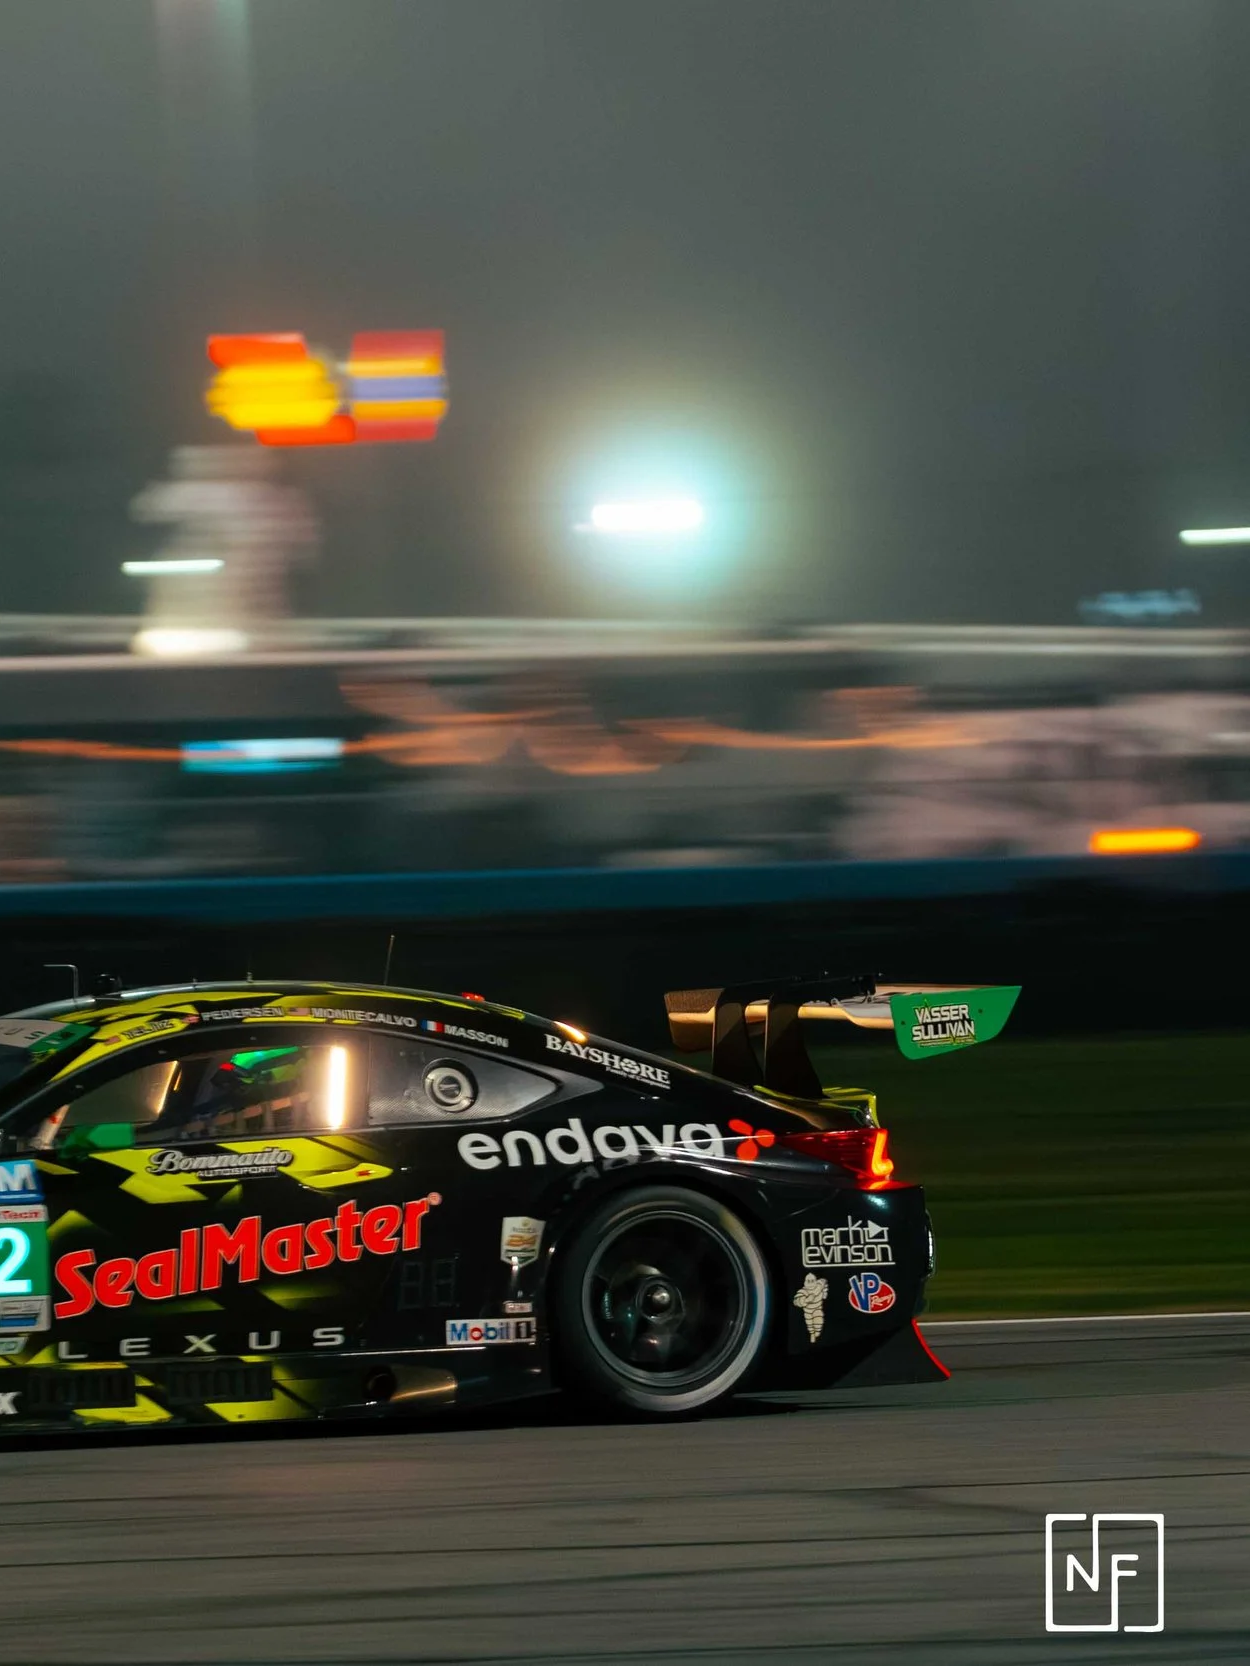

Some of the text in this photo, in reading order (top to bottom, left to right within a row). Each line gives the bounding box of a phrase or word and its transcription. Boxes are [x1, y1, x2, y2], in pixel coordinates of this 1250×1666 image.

[201, 1007, 284, 1021] PEDERSEN
[310, 1007, 417, 1028] MONTECALVO
[443, 1025, 509, 1048] MASSON
[912, 1020, 975, 1041] SULLIVAN
[915, 1004, 969, 1024] VASSER
[544, 1033, 671, 1084] BAYSHORE
[457, 1118, 726, 1170] endava
[196, 1165, 279, 1178] AUTOSPORT
[802, 1215, 865, 1246] mark
[54, 1198, 430, 1319] SealMaster
[849, 1272, 881, 1312] VP
[58, 1326, 346, 1360] LEXUS
[451, 1320, 530, 1342] Mobil 1
